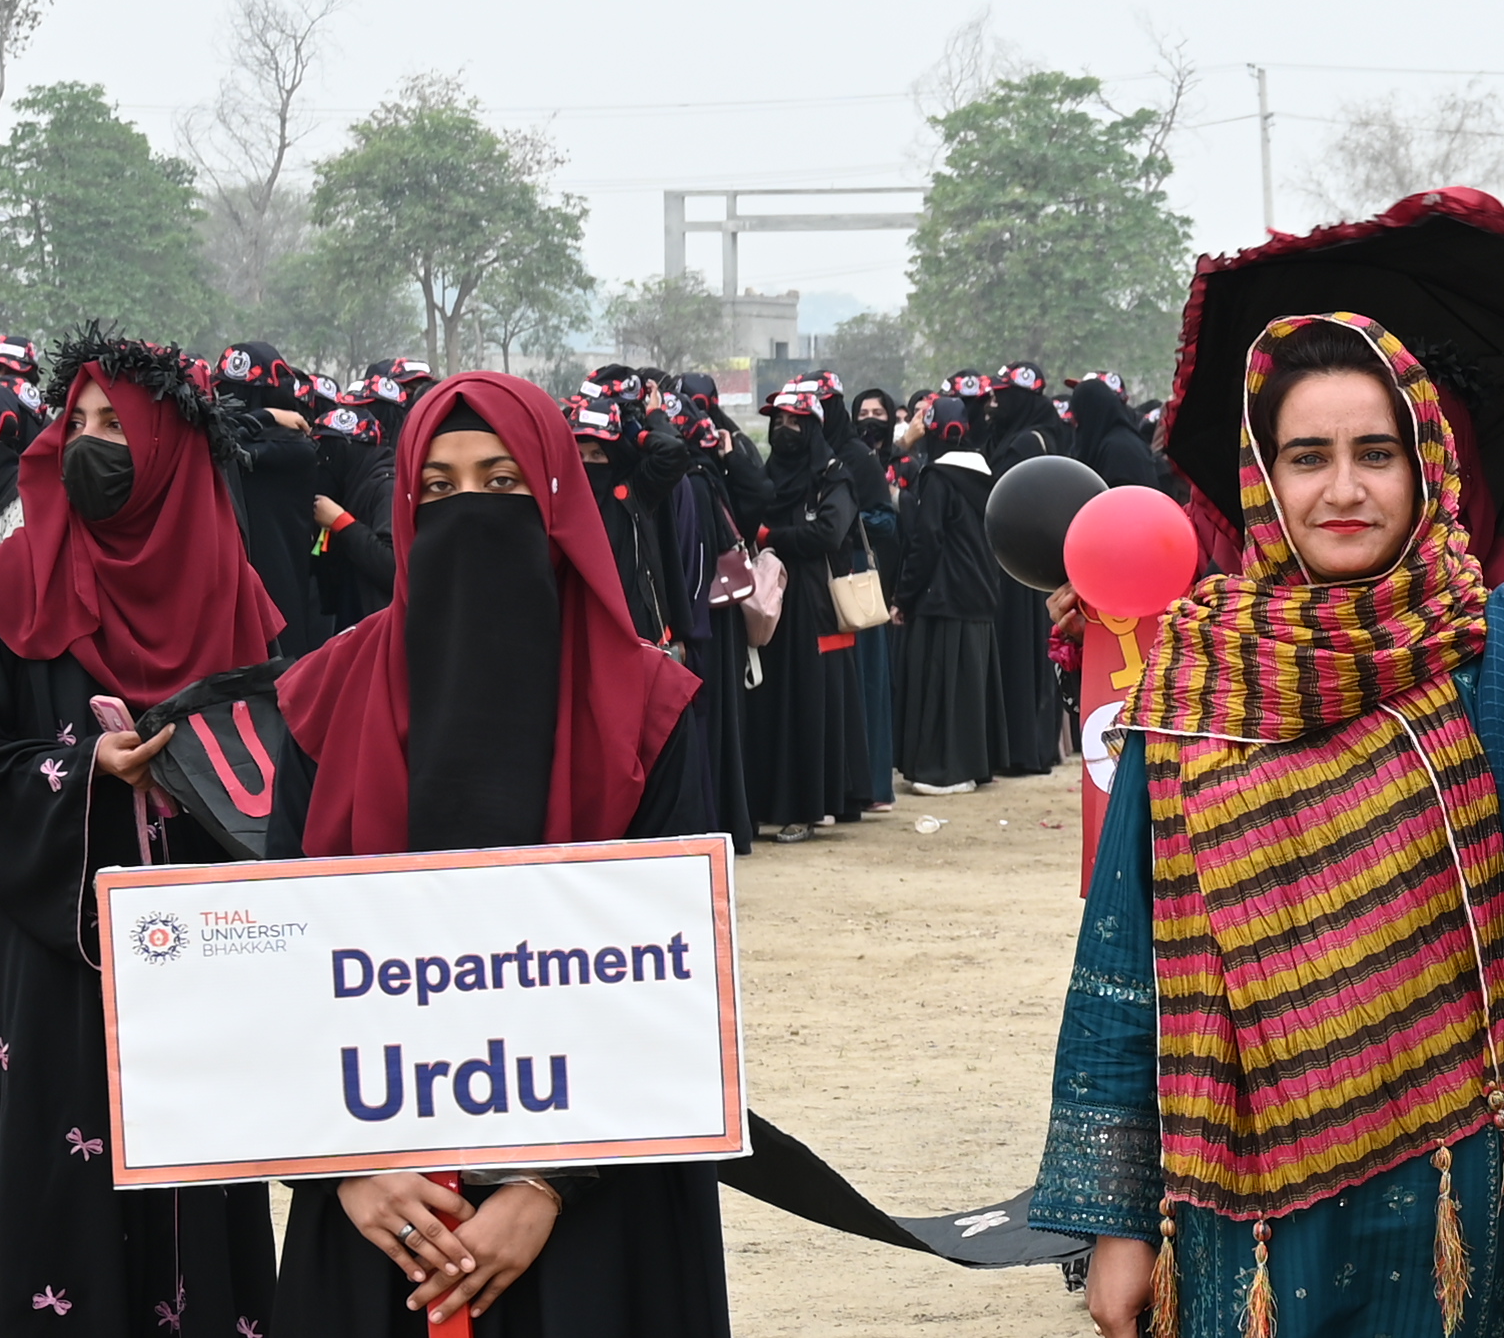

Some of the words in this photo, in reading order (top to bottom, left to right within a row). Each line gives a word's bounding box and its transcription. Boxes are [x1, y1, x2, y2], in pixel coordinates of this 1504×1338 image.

[199, 909, 257, 927] THAL
[200, 922, 308, 942] UNIVERSITY
[202, 938, 287, 958] BHAKKAR
[332, 931, 691, 1006] Department
[340, 1038, 569, 1123] Urdu
